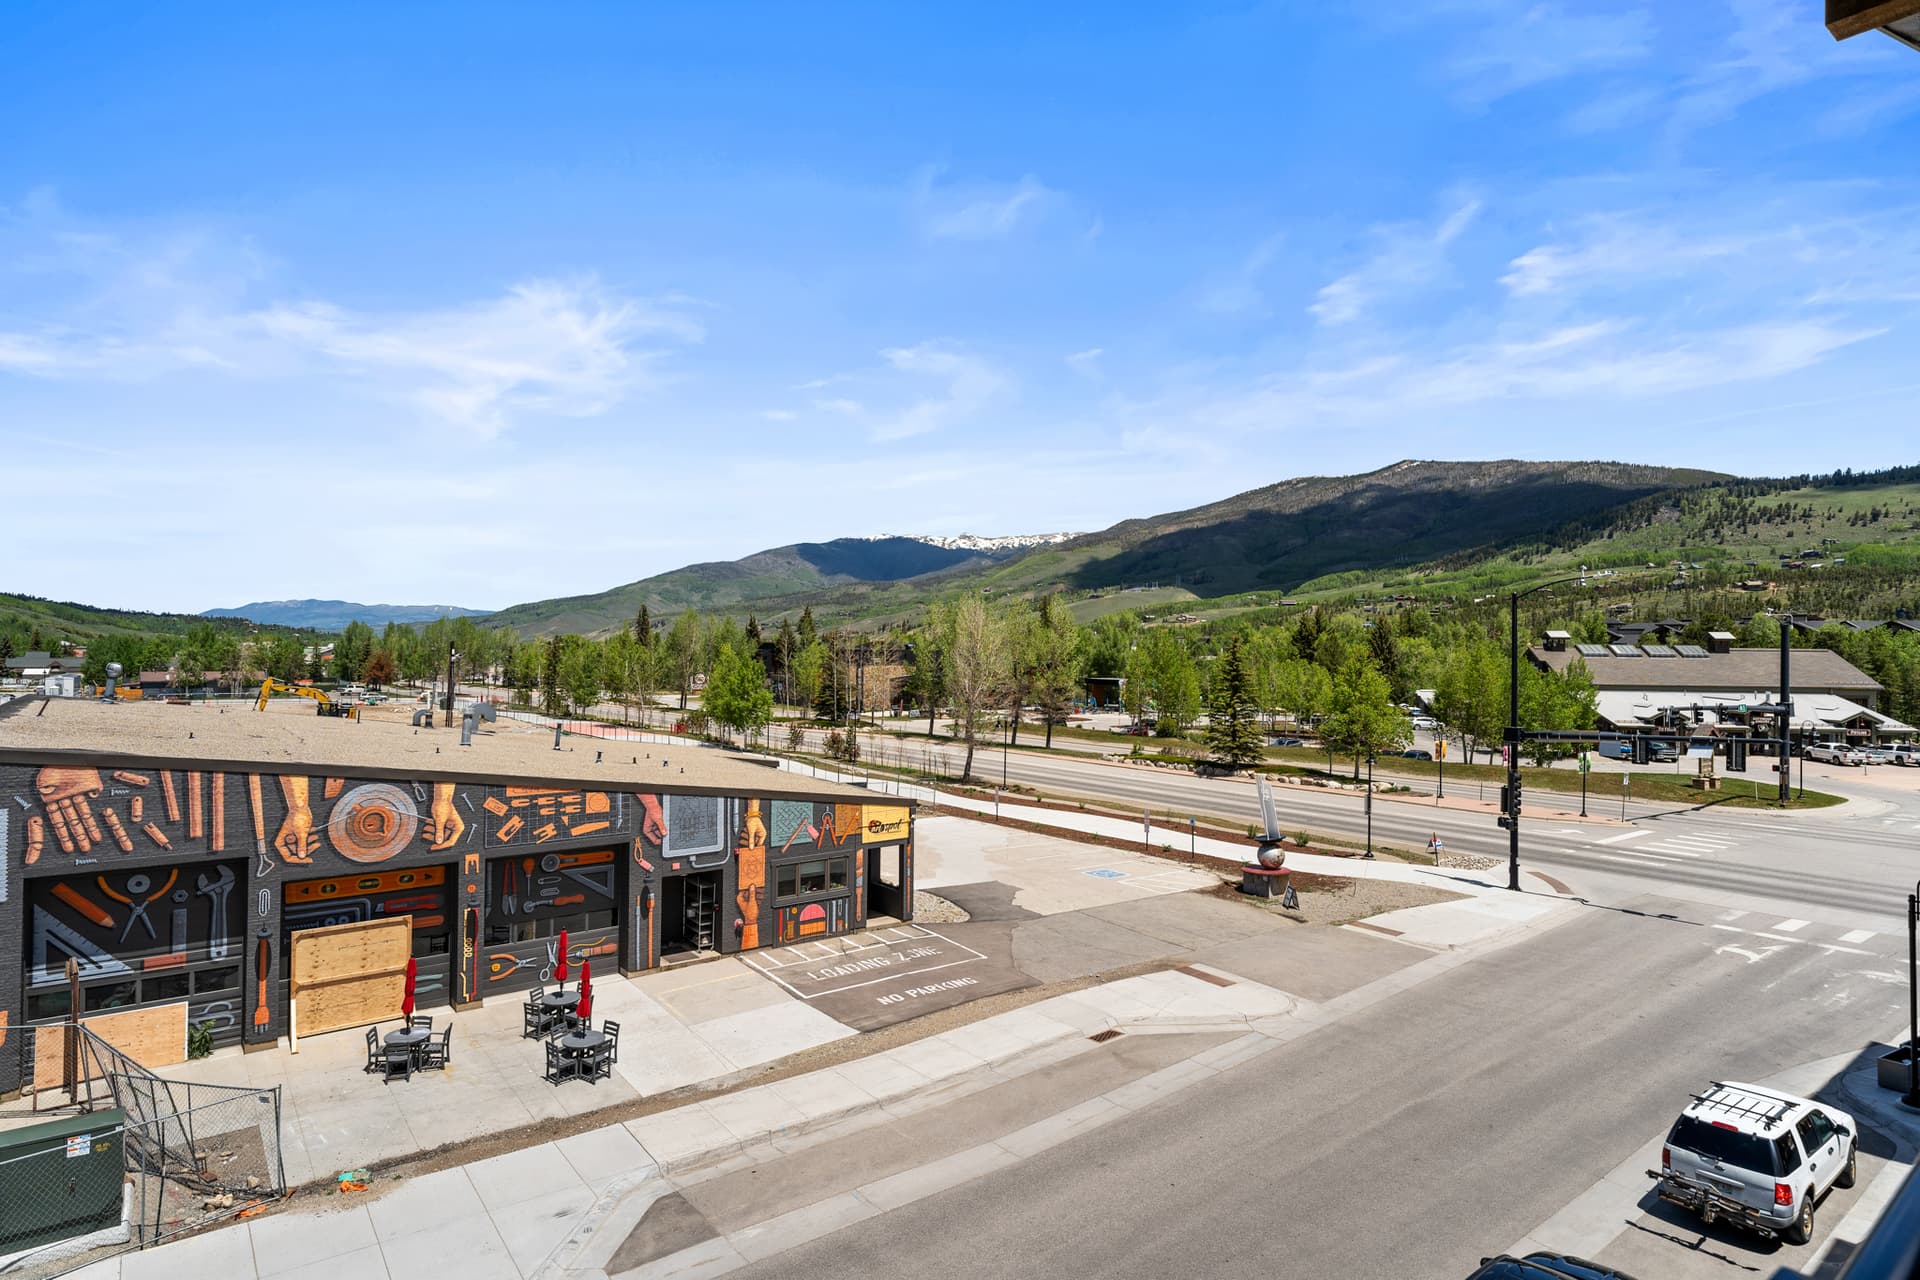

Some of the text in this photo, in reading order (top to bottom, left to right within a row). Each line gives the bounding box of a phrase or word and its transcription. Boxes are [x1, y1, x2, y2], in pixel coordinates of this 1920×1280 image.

[807, 956, 891, 981] LOADING
[875, 977, 980, 1005] NO PARKING
